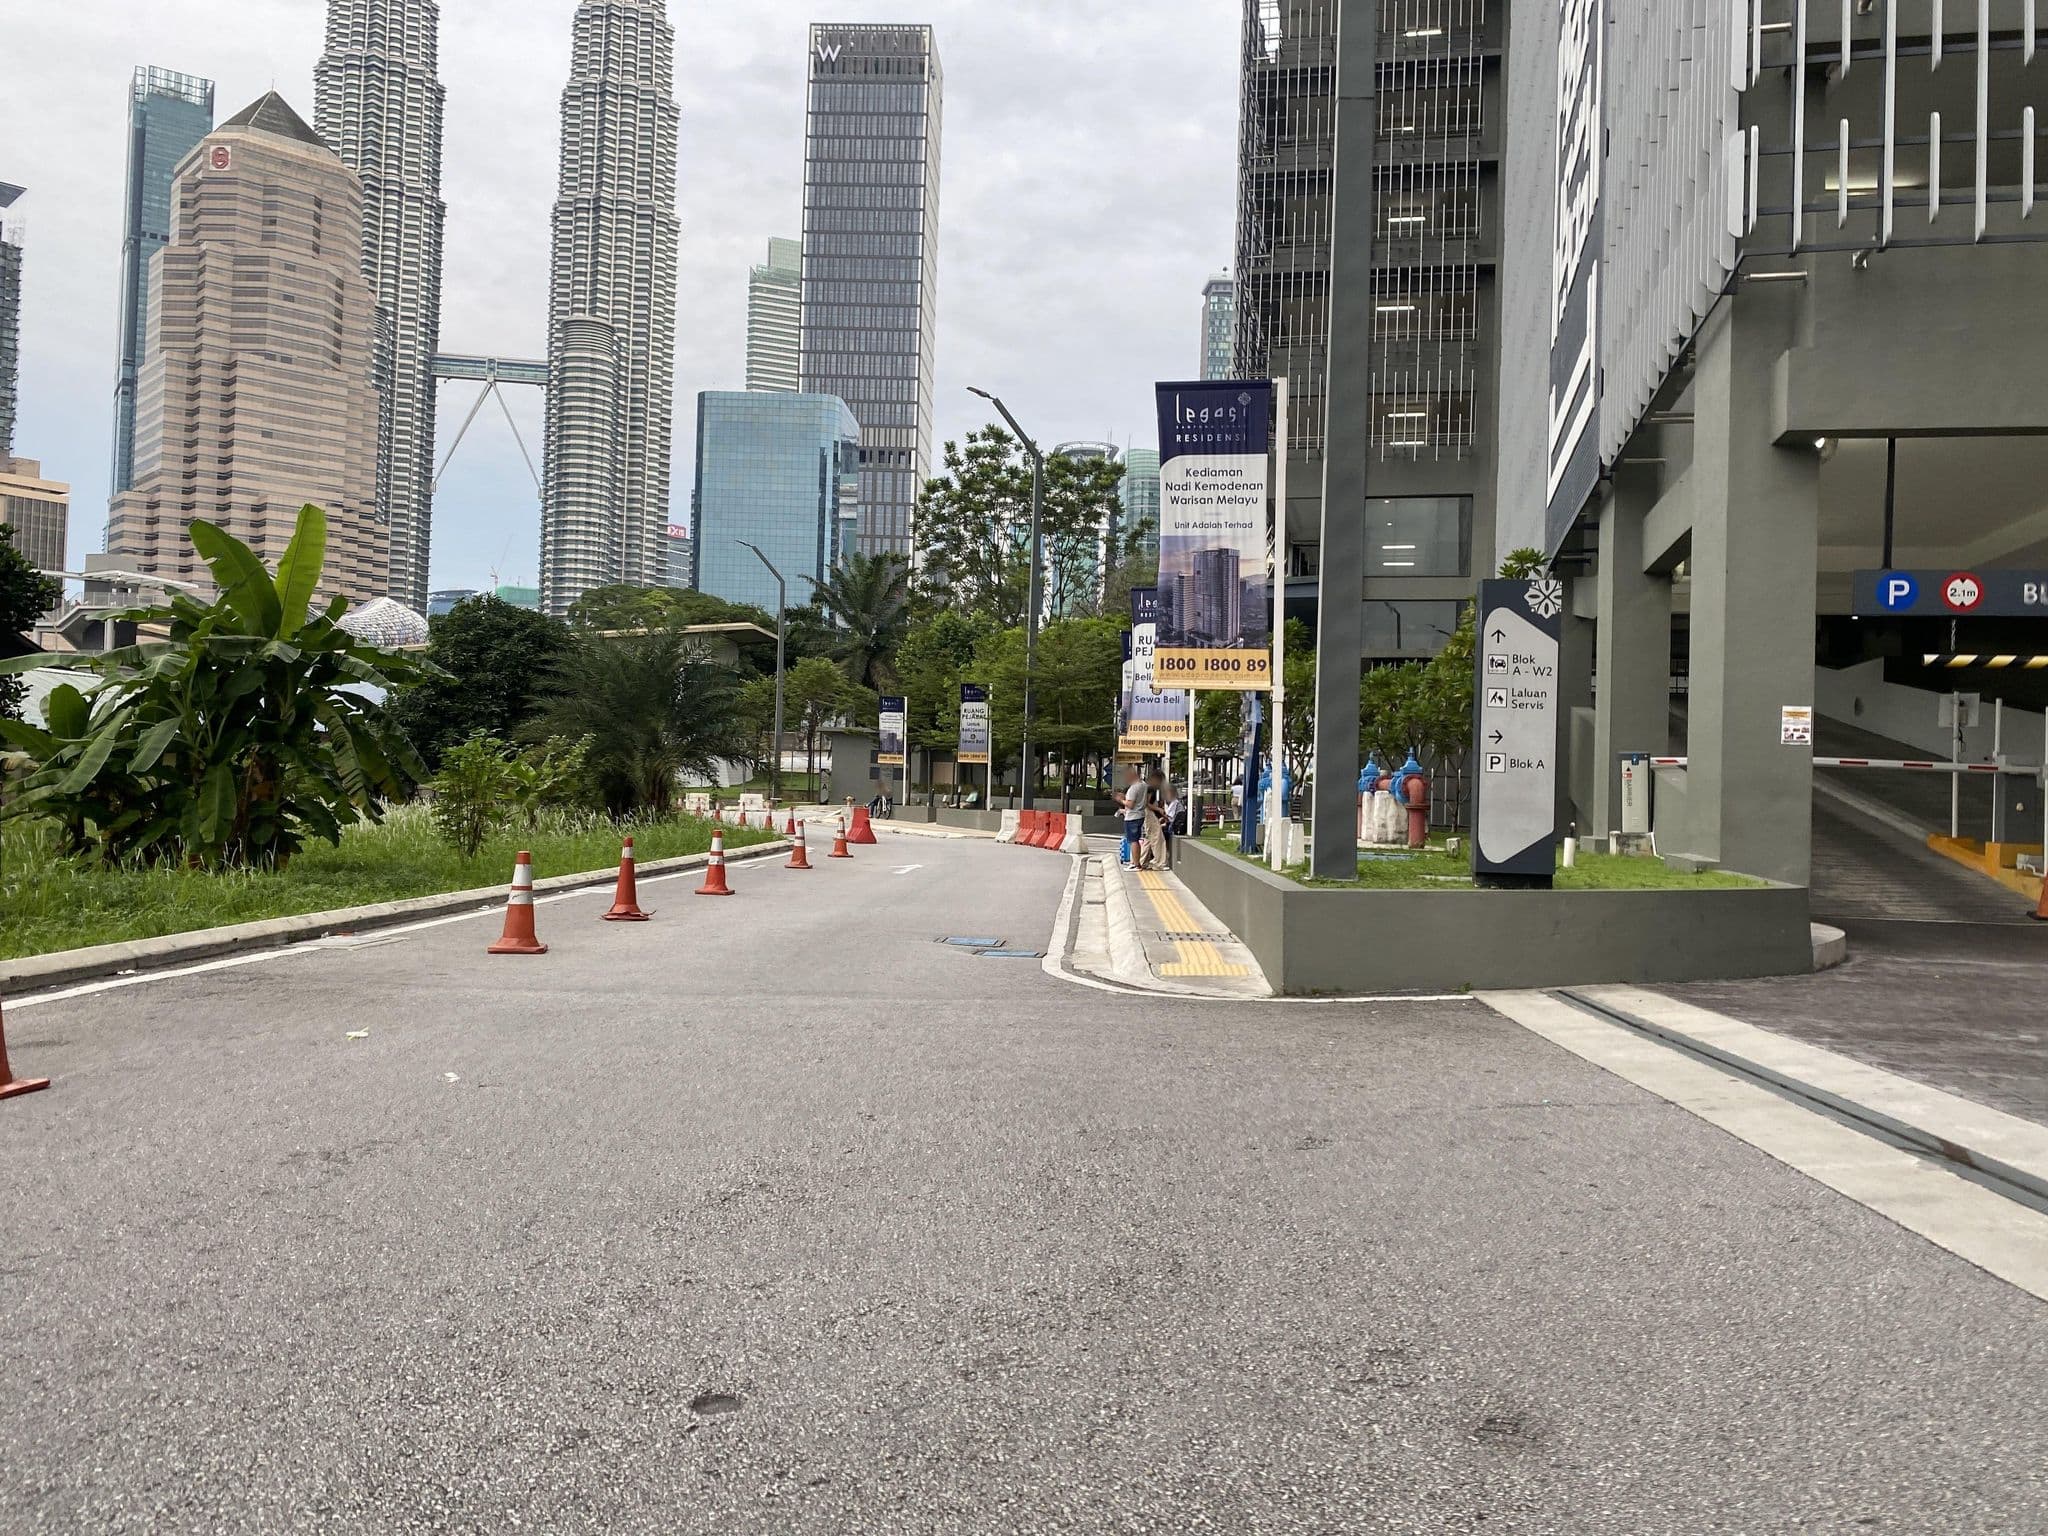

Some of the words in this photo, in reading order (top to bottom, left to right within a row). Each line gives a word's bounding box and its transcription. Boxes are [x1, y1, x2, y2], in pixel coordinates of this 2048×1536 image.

[816, 44, 842, 62] W
[1176, 434, 1246, 442] RESIDENSI
[1185, 468, 1243, 477] Kediaman
[1165, 482, 1192, 491] Nadi
[1194, 481, 1264, 491] Kemodenan
[1170, 495, 1213, 505] Warisan
[1216, 495, 1258, 506] Melayu
[1192, 521, 1222, 529] Adalah
[1224, 521, 1253, 529] Terhad
[1888, 579, 1911, 606] P
[1950, 587, 1976, 598] 2.1m
[1139, 635, 1153, 645] RU
[1135, 646, 1153, 656] PEJ
[1513, 654, 1536, 664] Blok
[1160, 657, 1196, 671] 1800
[1204, 658, 1241, 671] 1800
[1246, 658, 1267, 672] 89
[1512, 666, 1521, 676] A
[1533, 666, 1552, 676] W2
[1511, 688, 1547, 698] Laluan
[1135, 695, 1161, 704] Sewa
[1163, 695, 1180, 704] Beli
[1511, 699, 1545, 710] Servis
[1129, 724, 1149, 732] 1800
[1152, 725, 1172, 733] 1800
[1174, 725, 1185, 733] 89
[1490, 756, 1501, 770] P
[1509, 758, 1533, 769] Blok
[1536, 759, 1545, 770] A
